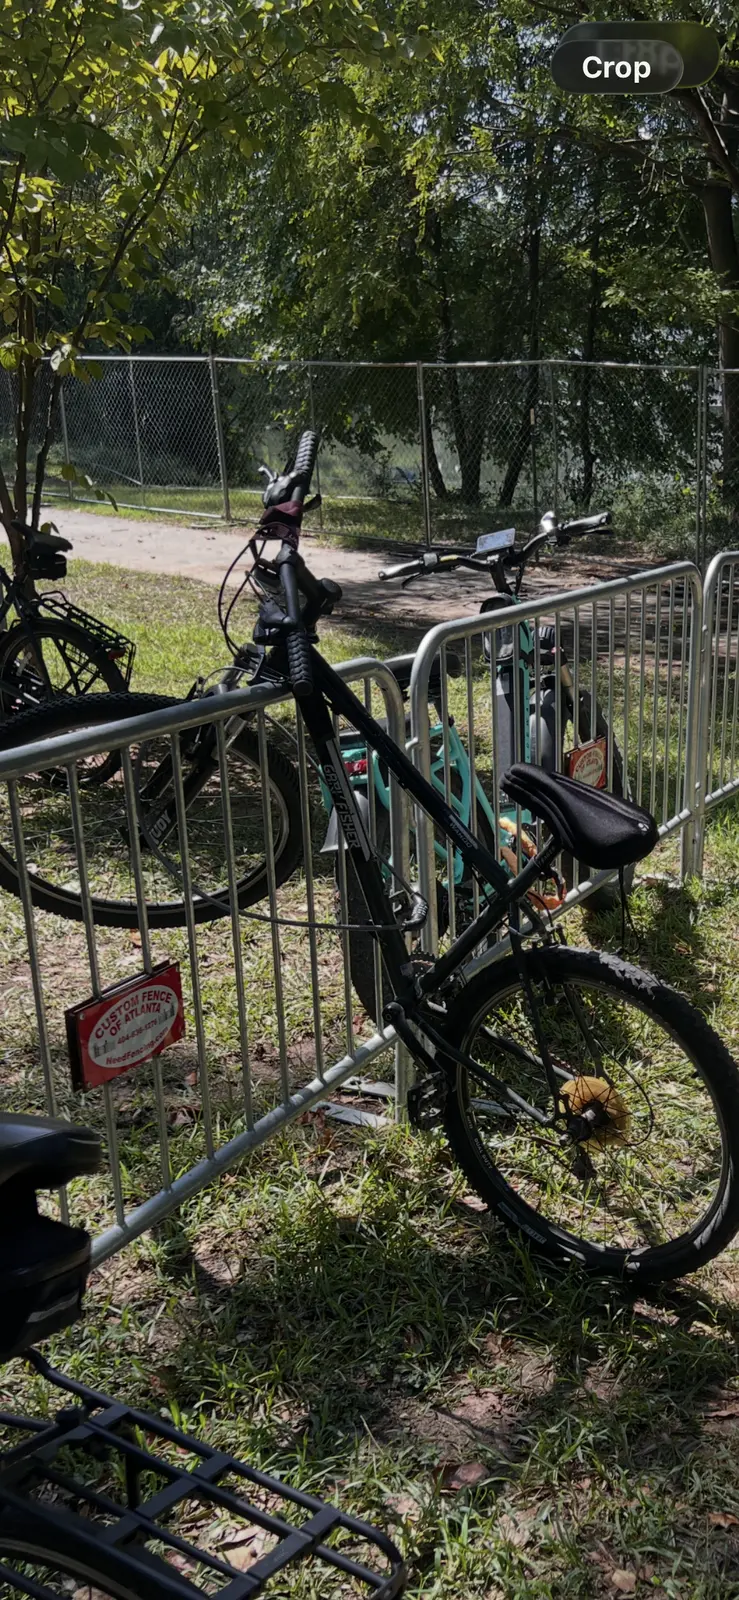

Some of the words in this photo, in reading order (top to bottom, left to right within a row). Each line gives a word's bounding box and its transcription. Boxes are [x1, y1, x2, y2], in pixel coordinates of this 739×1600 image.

[323, 764, 346, 800] GARY
[335, 799, 361, 848] FISHER
[449, 822, 473, 848] WAHOO
[94, 995, 139, 1039] CUSTOM
[141, 990, 173, 1004] FENCE
[109, 1021, 123, 1037] OF
[124, 1002, 161, 1025] ATLANTA
[105, 1026, 169, 1065] NeedFencing.com
